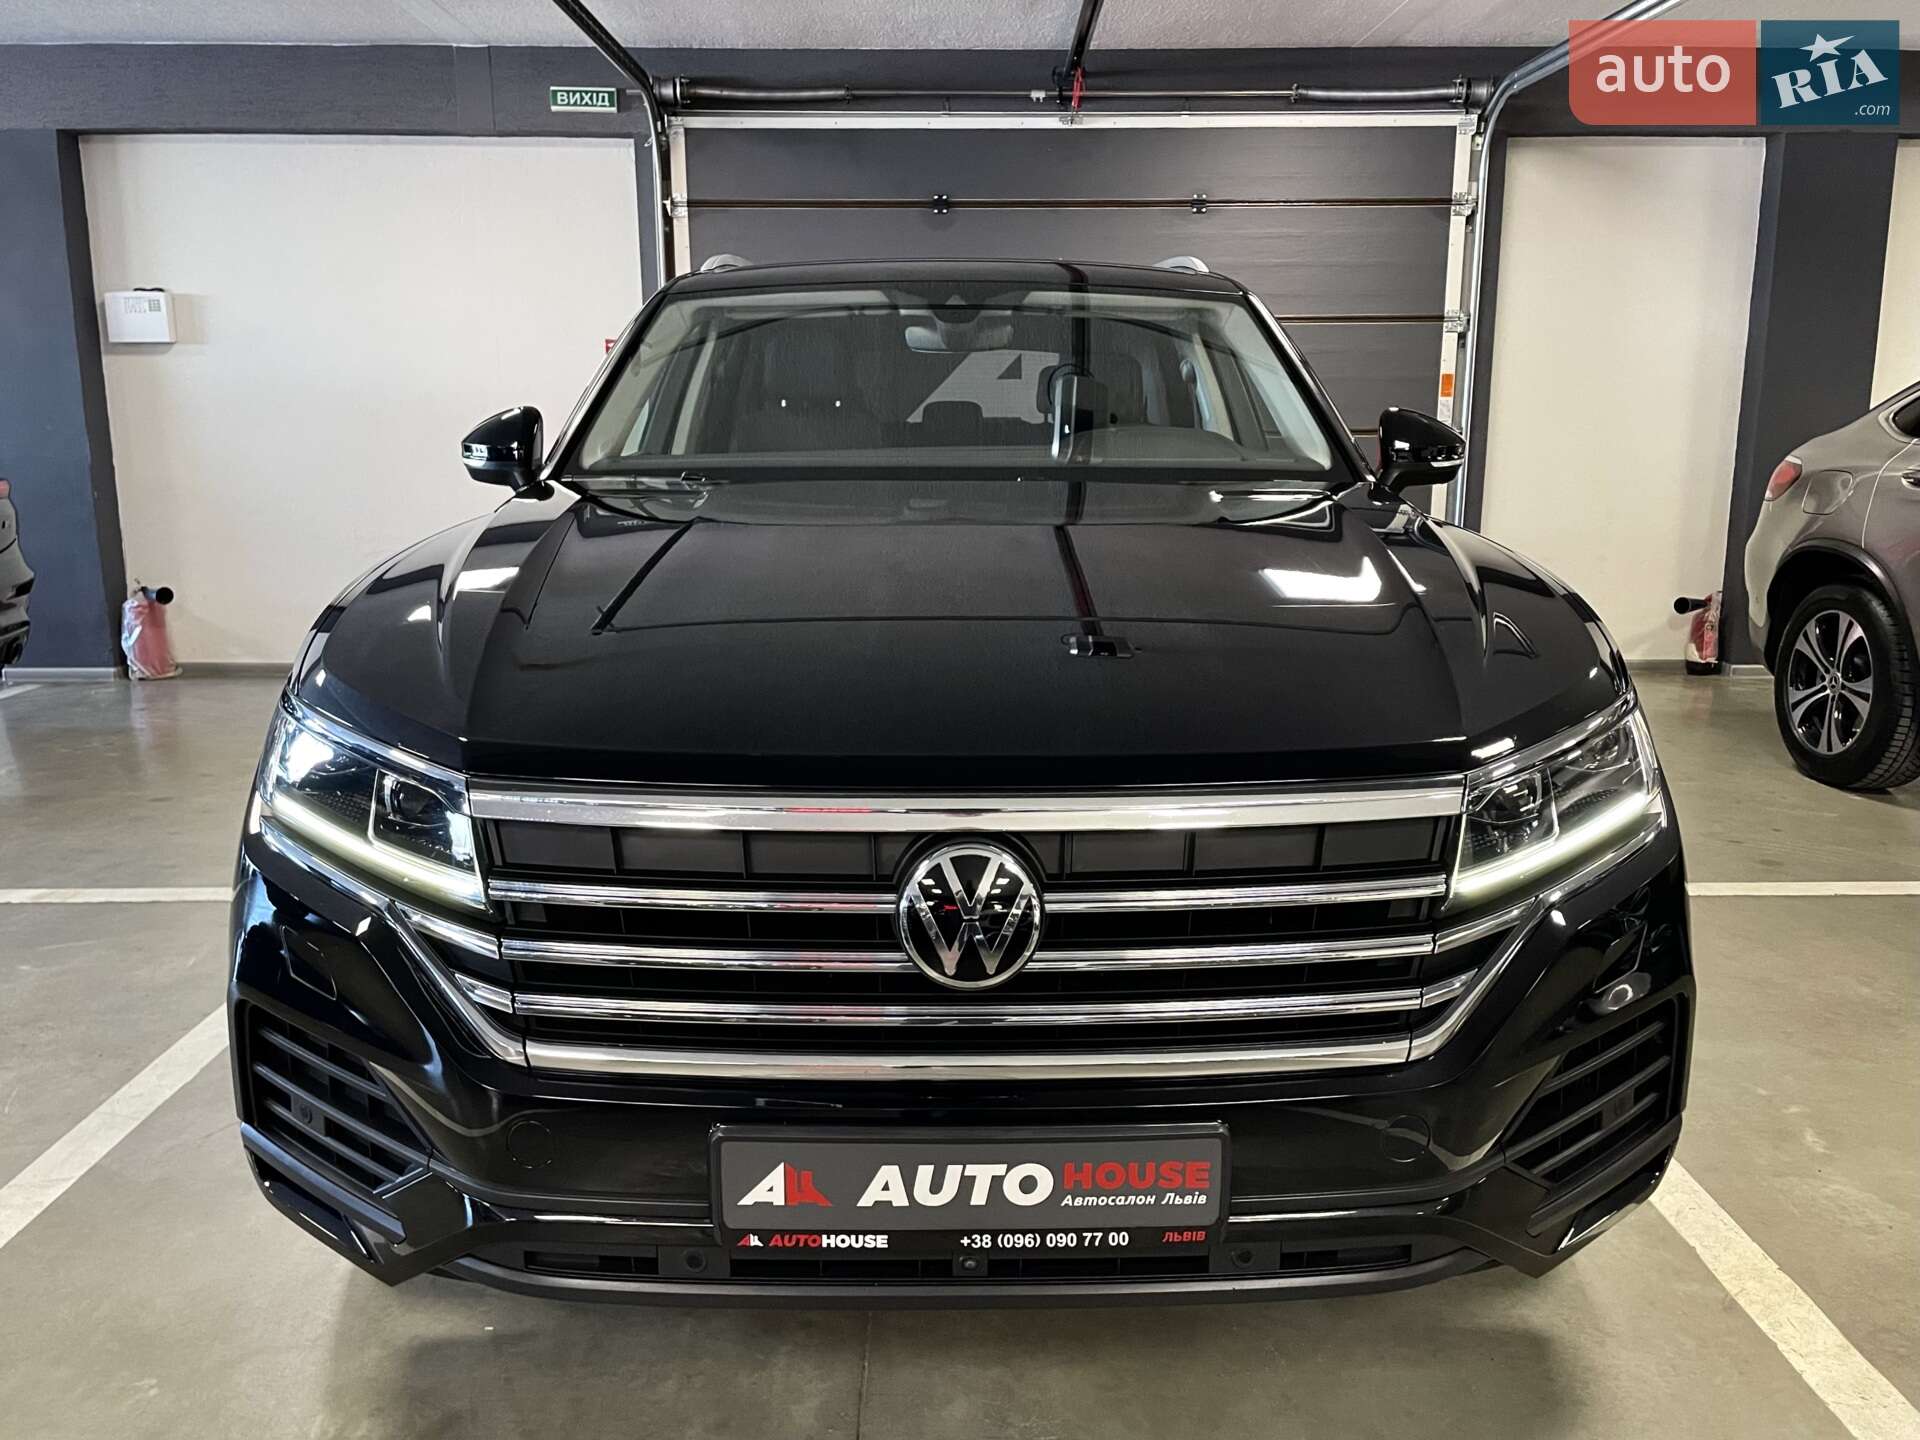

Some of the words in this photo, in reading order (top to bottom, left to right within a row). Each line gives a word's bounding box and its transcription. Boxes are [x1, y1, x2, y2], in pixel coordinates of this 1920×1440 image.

[556, 91, 610, 107] ВИХІД
[856, 1163, 1054, 1207] AUTO
[1062, 1161, 1211, 1190] HOUSE
[1061, 1194, 1156, 1207] Автосалон
[1161, 1191, 1207, 1205] Львів
[768, 1234, 889, 1249] AUTOHOUSE
[960, 1234, 992, 1248] +38
[997, 1234, 1041, 1249] (096)
[1046, 1232, 1077, 1247] 090
[1082, 1232, 1103, 1247] 77
[1108, 1231, 1129, 1246] 00
